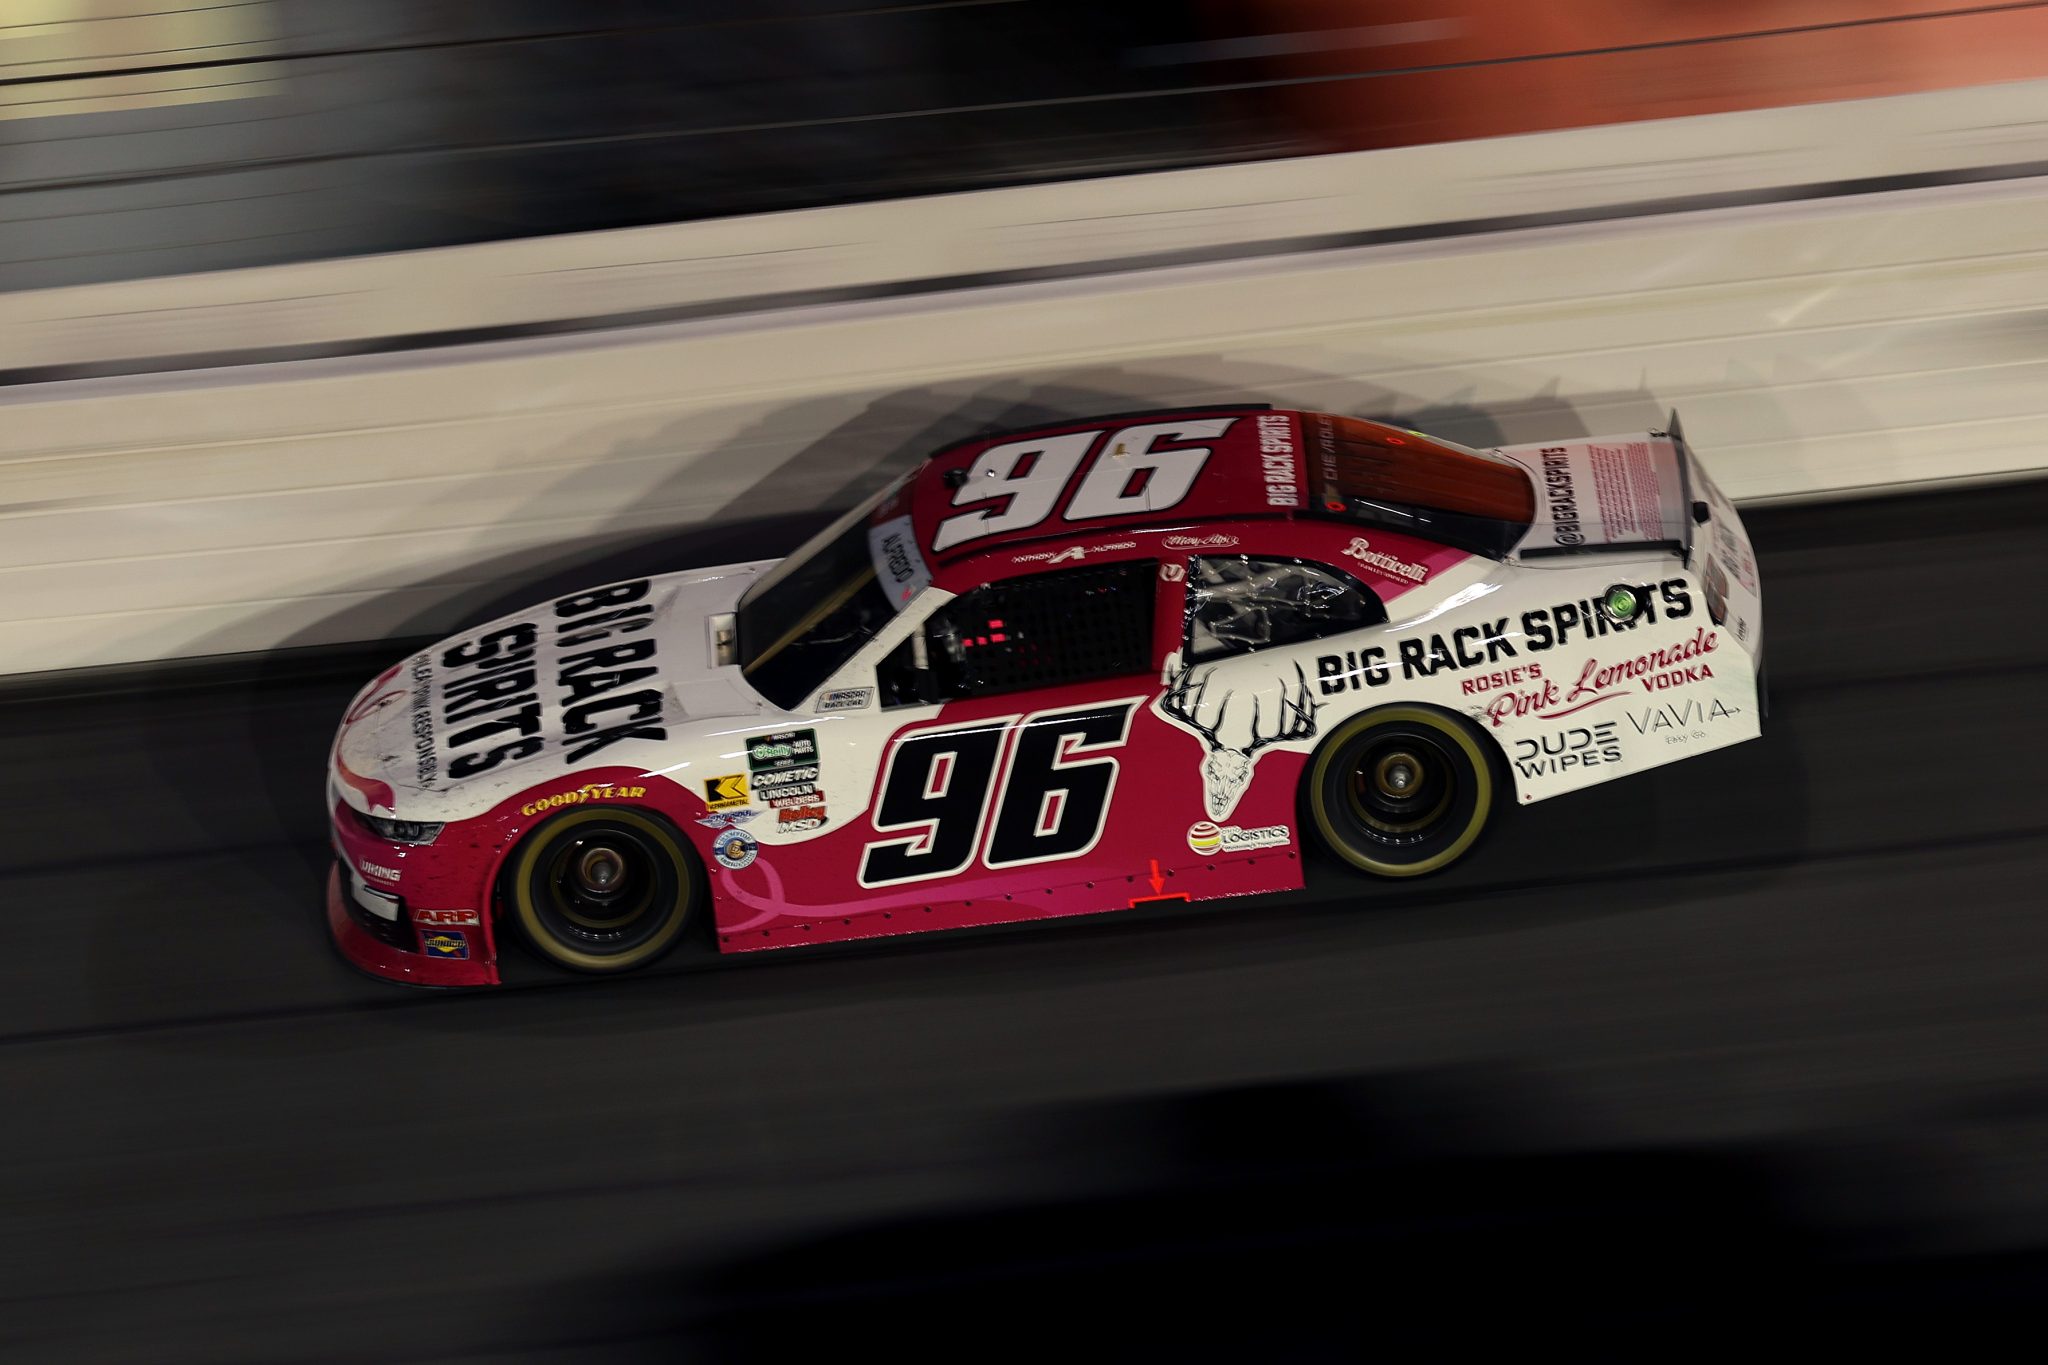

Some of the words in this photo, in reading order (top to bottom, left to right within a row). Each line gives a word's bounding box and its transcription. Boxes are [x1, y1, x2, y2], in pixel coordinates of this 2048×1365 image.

[1256, 415, 1294, 454] SPIRITS
[1319, 415, 1338, 481] CHEVROLE
[932, 416, 1239, 553] 96
[1260, 453, 1297, 484] RACK
[1266, 483, 1298, 506] BIG
[1540, 447, 1585, 546] @BIGRACKSPIRITS
[881, 532, 914, 583] ALFREDO
[1011, 552, 1057, 563] ANTHONY
[1092, 541, 1137, 552] ALFREDO
[1340, 537, 1429, 582] Botticelli
[553, 579, 655, 648] BIG
[1317, 646, 1390, 695] BIG
[1398, 618, 1519, 680] RACK
[1521, 578, 1693, 651] SPIRTS
[1460, 663, 1543, 696] ROSIE'S
[1487, 679, 1560, 728] Pink
[1566, 625, 1720, 702] Lemonade
[1641, 663, 1715, 693] VODKA
[441, 622, 545, 779] SPIRITS
[557, 638, 668, 765] RACK
[1625, 698, 1734, 735] VAVIA
[411, 710, 438, 784] RESPONSIBLY
[1514, 721, 1618, 761] DUDE
[752, 766, 819, 787] COMETIC
[1514, 745, 1623, 779] WIPES
[521, 784, 648, 817] GOODYEAR
[709, 799, 750, 810] KENNAMETAL
[760, 784, 815, 800] LINCOLN
[772, 794, 821, 807] WELDERS
[856, 695, 1150, 889] 96
[776, 818, 822, 834] MSD
[1221, 826, 1289, 844] LOGISTICS
[413, 908, 480, 926] ARP
